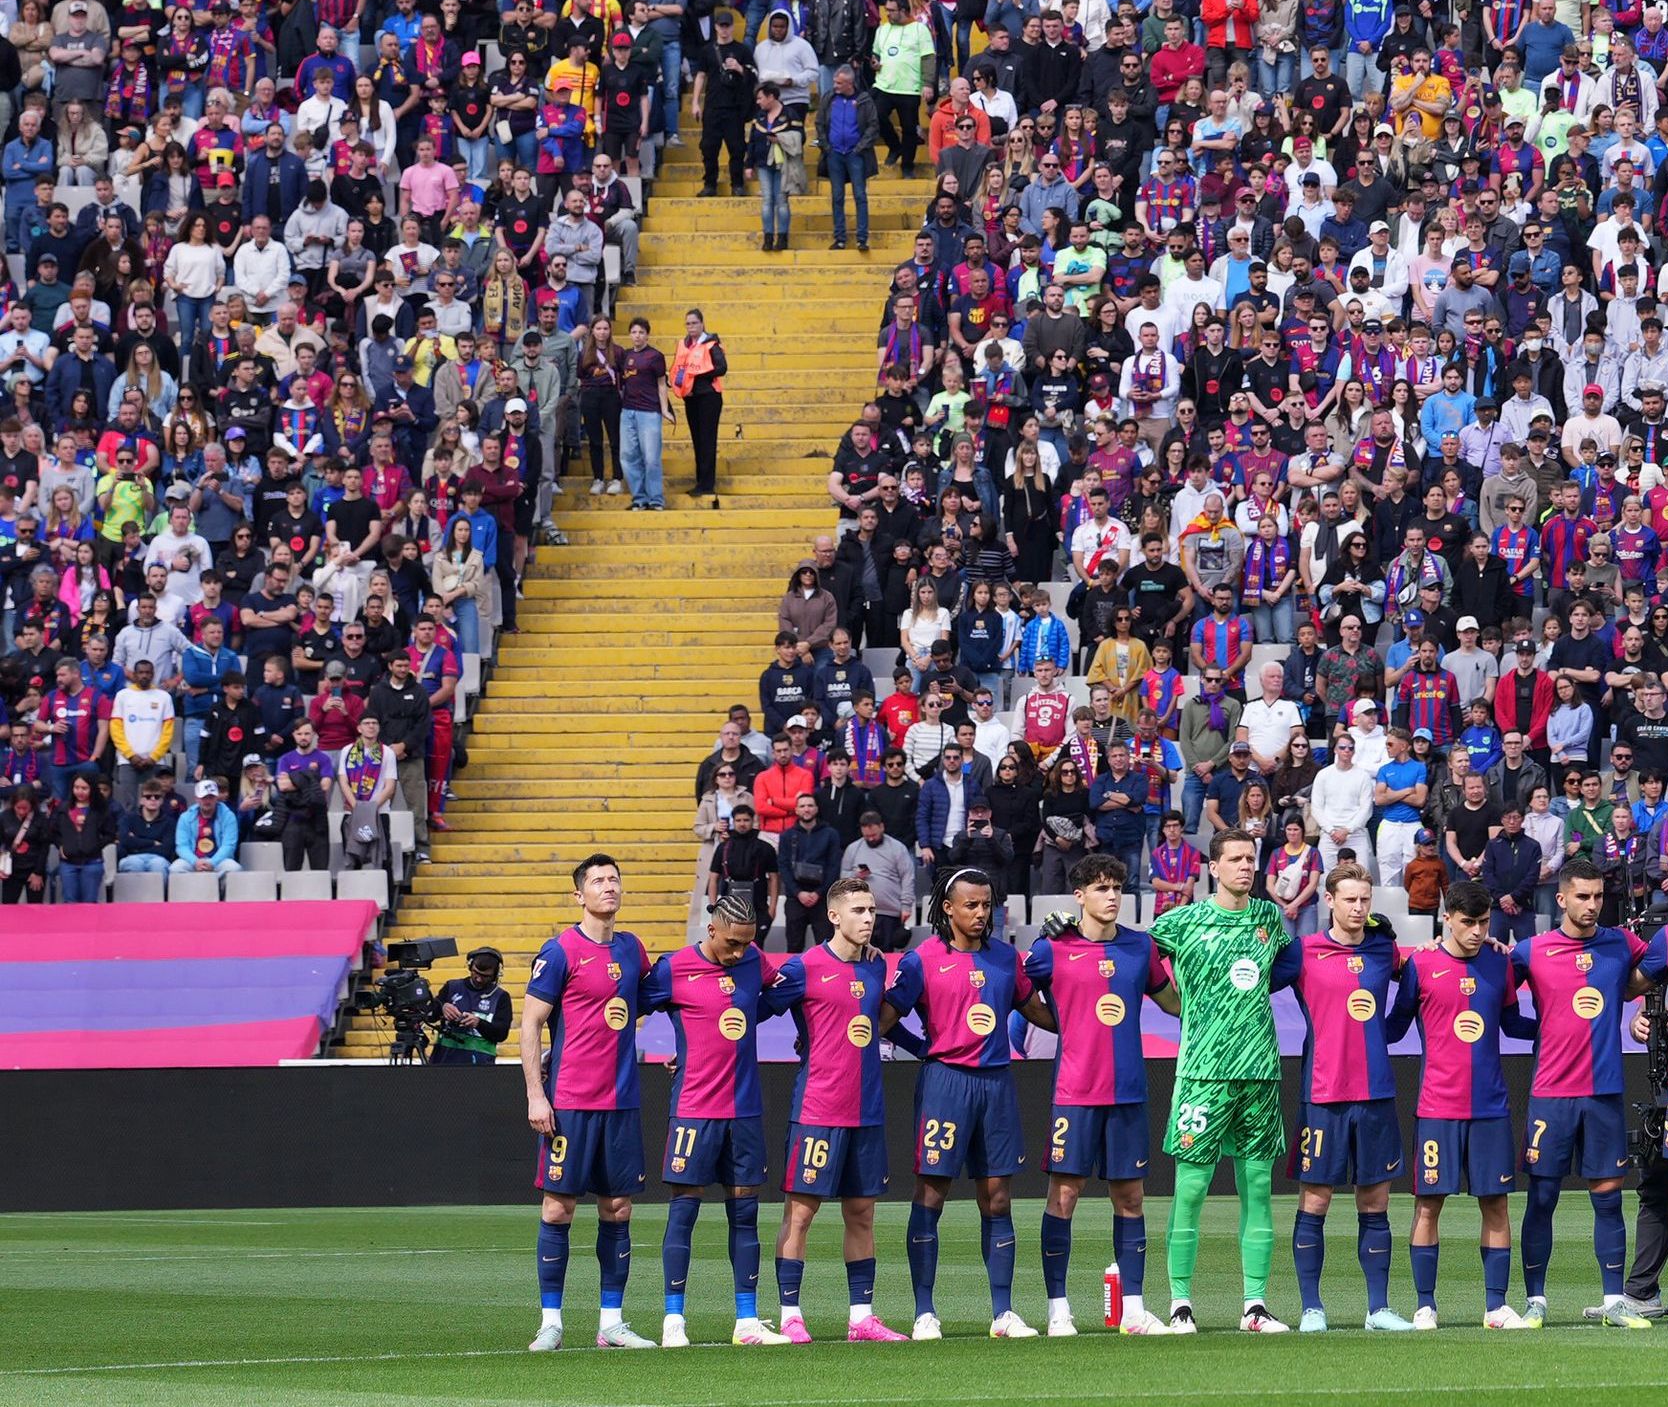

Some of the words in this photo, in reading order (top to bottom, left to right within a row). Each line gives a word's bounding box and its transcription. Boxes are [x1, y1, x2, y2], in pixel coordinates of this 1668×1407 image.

[1498, 547, 1525, 556] QATAR
[1413, 690, 1436, 699] unicef
[1052, 1117, 1069, 1147] 2
[1176, 1102, 1209, 1135] 25
[675, 1128, 698, 1157] 11
[923, 1119, 957, 1151] 23
[1299, 1127, 1323, 1156] 21
[1532, 1119, 1547, 1149] 7
[550, 1135, 568, 1163] 9
[803, 1138, 830, 1167] 16
[1423, 1140, 1440, 1167] 8
